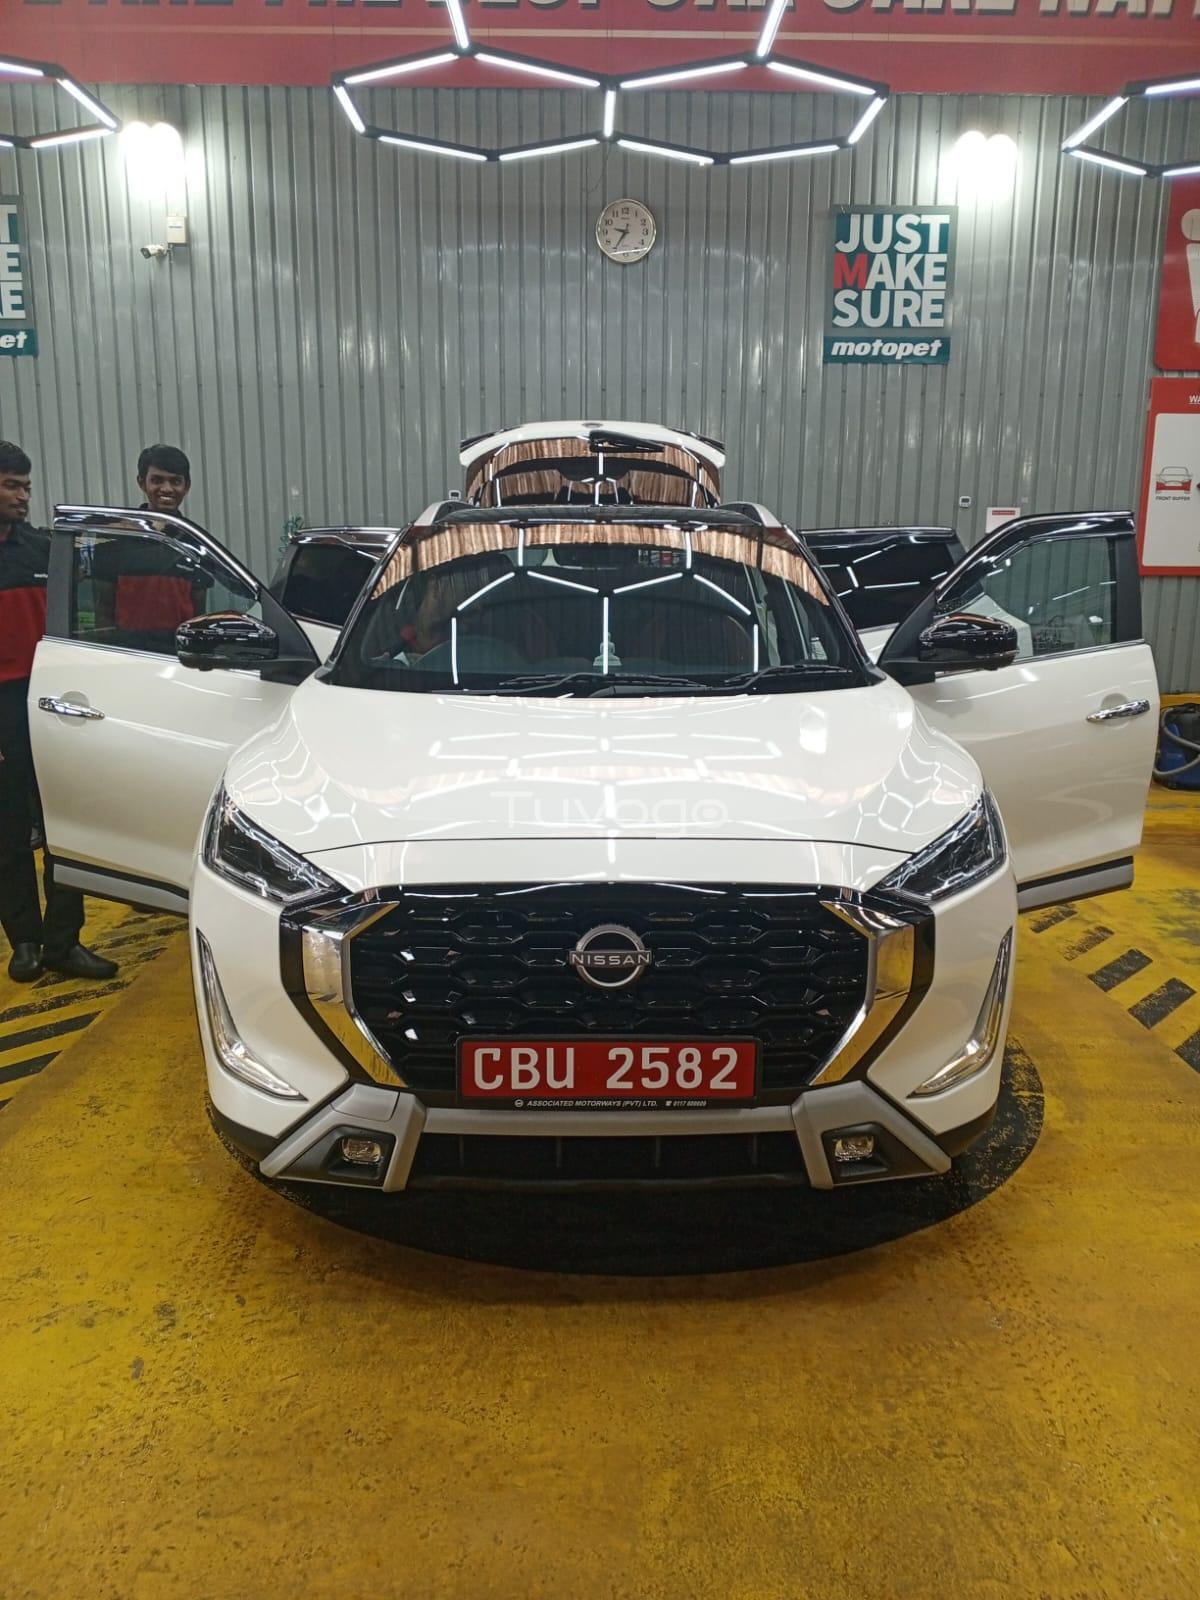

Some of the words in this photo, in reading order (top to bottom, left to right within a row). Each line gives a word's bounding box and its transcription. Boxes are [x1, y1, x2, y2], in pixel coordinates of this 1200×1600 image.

[835, 213, 950, 254] JUST
[833, 253, 948, 290] MAKE
[832, 289, 946, 328] SURE
[831, 339, 943, 360] motopet
[572, 953, 650, 966] NISSAN
[474, 1047, 575, 1090] CBU
[606, 1047, 738, 1090] 2582
